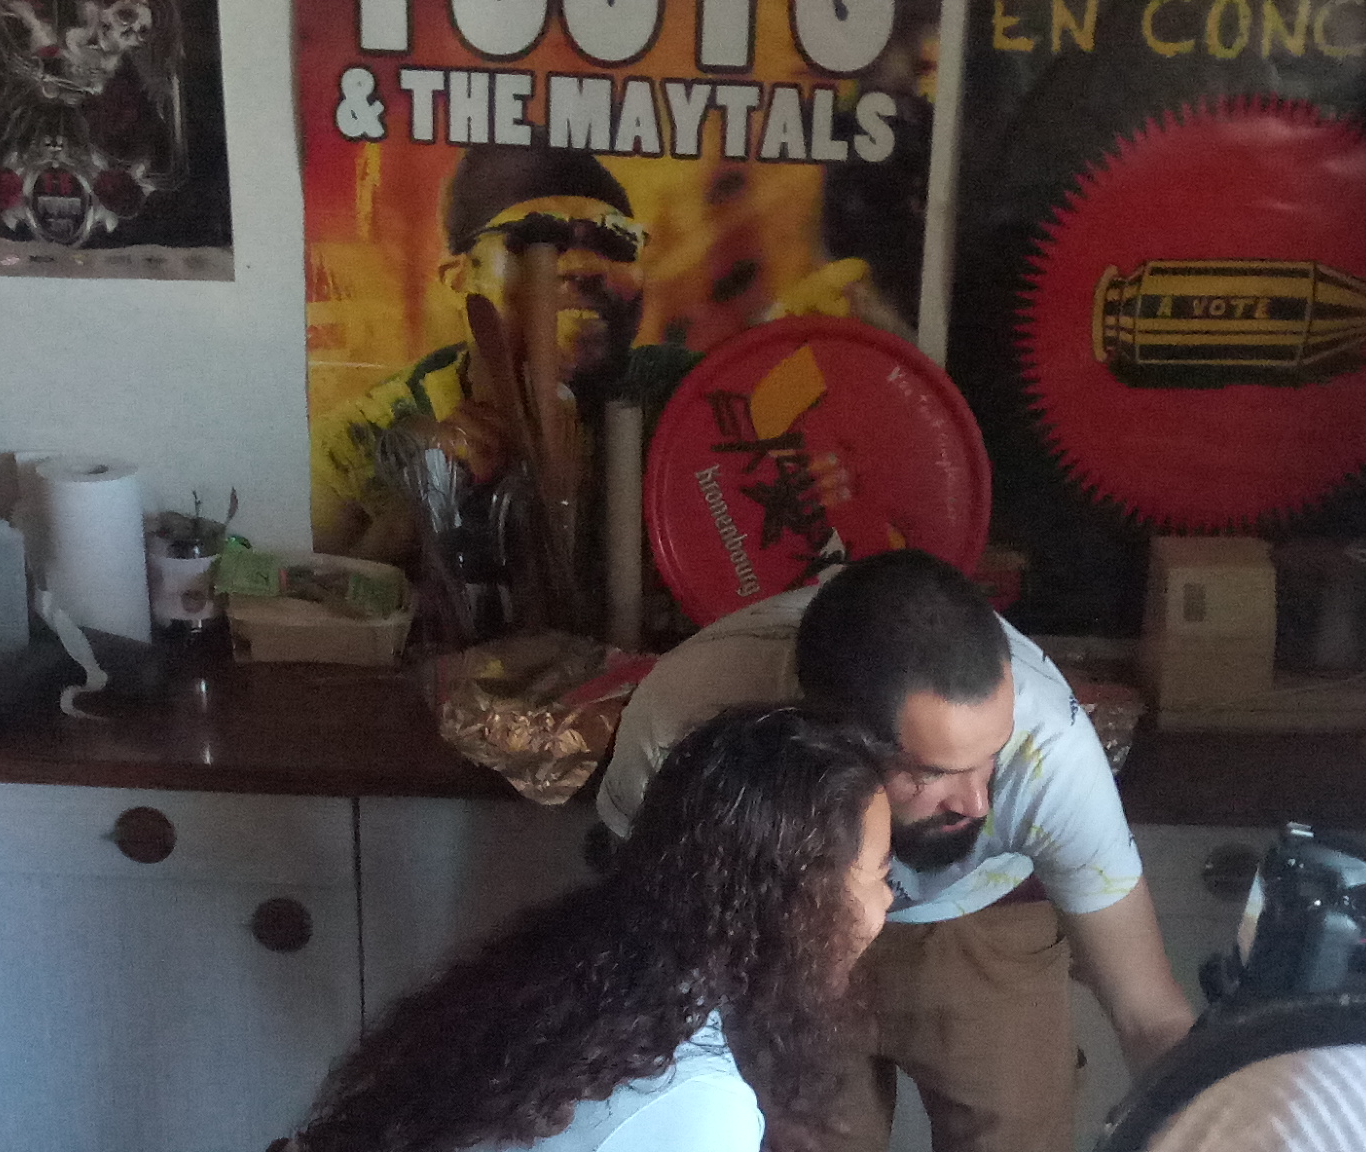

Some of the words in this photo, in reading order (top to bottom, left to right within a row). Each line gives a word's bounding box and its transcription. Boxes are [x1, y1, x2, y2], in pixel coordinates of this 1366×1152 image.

[992, 0, 1096, 53] EN
[336, 68, 384, 138] &
[400, 69, 532, 146] THE
[548, 74, 897, 163] MAYTALS
[1156, 296, 1173, 317] A
[1193, 297, 1271, 319] VOTE
[695, 463, 761, 598] Kronenbourg
